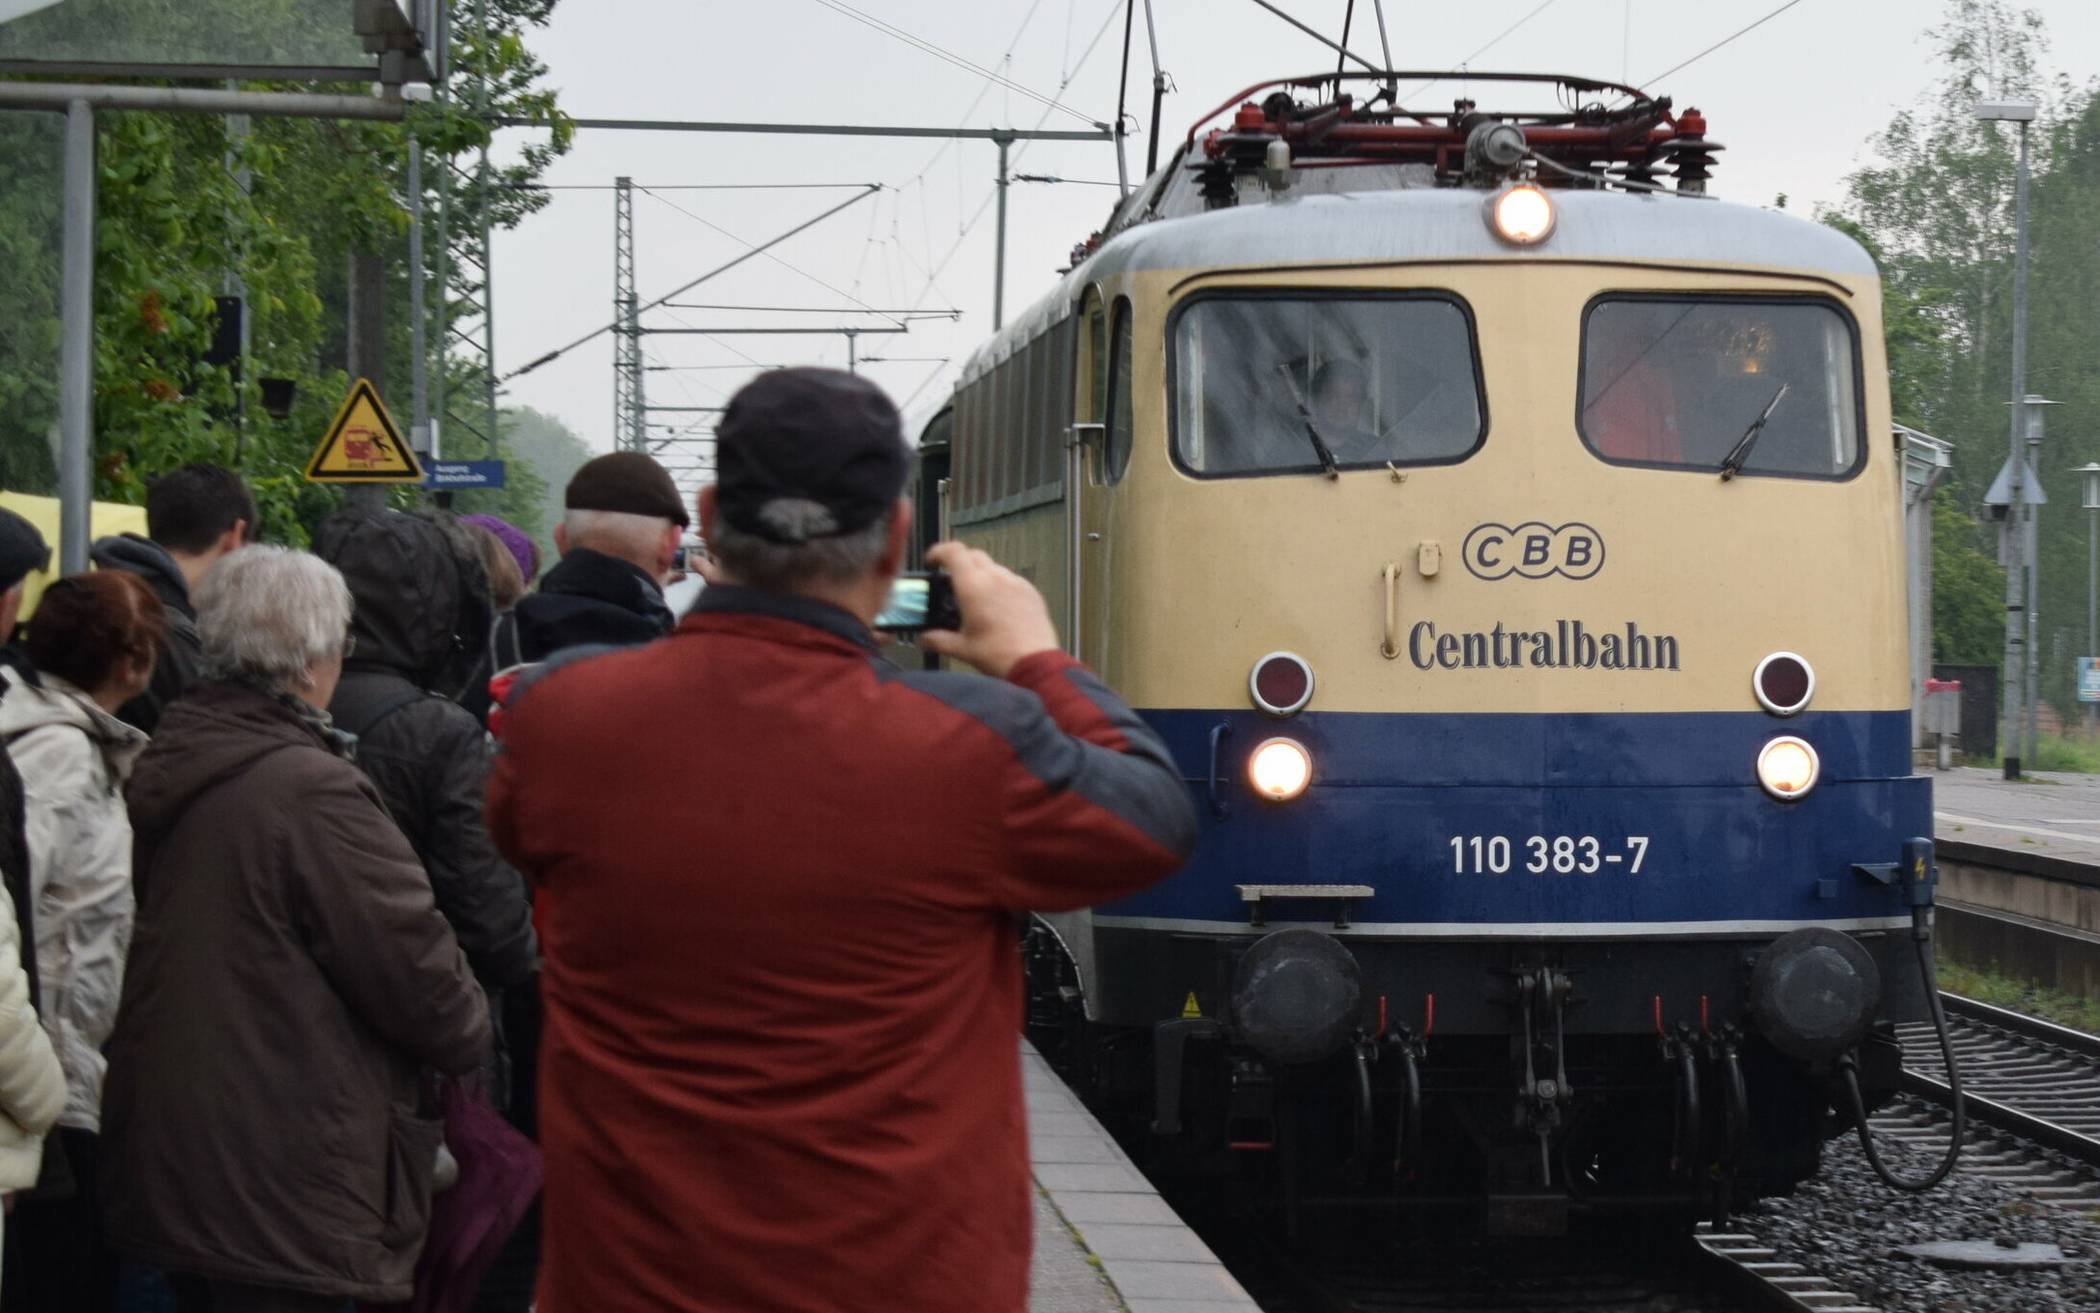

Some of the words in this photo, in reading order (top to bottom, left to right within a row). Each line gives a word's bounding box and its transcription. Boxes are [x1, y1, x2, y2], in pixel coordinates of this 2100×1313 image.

[1476, 535, 1593, 567] CBB
[1408, 620, 1681, 672] Centralbahn
[1450, 836, 1511, 874] 110
[1525, 836, 1649, 874] 383-7
